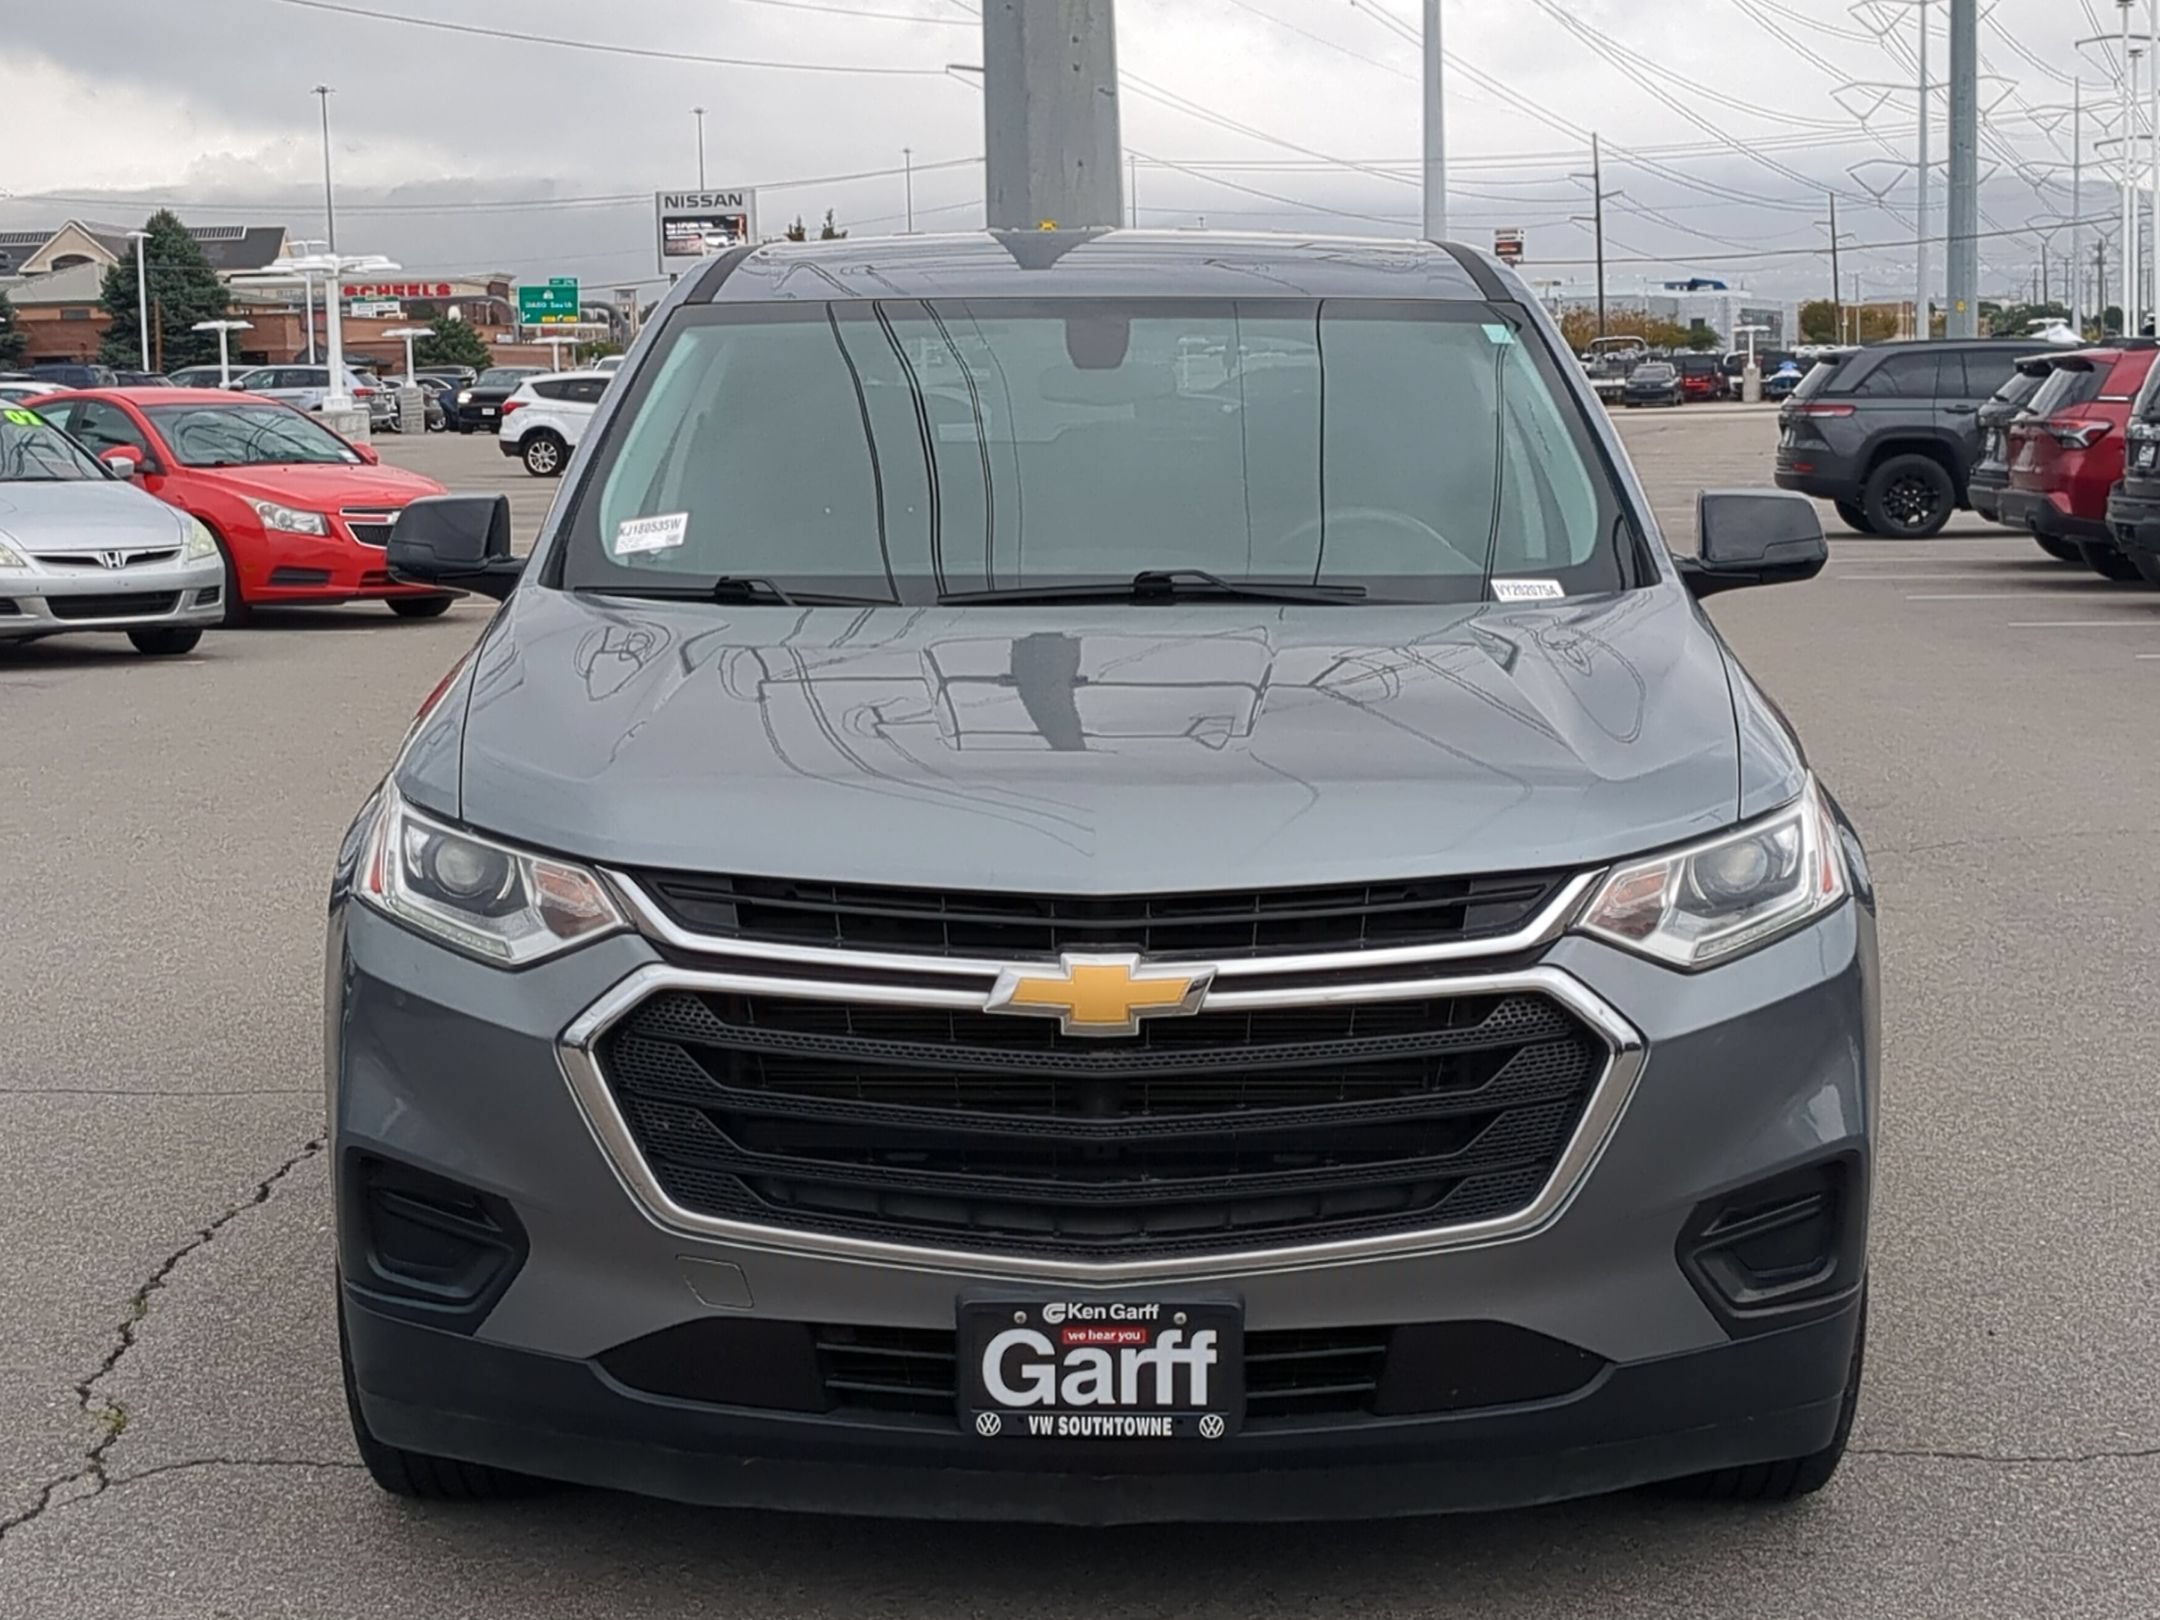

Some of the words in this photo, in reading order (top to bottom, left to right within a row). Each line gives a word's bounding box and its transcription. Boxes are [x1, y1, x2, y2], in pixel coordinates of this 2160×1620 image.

[664, 193, 743, 209] NISSAN
[343, 283, 451, 297] SCHEELS
[3, 409, 44, 426] 07
[1067, 1303, 1107, 1320] Ken
[1109, 1303, 1160, 1320] Garff
[1067, 1330, 1086, 1341] we
[1088, 1329, 1115, 1341] hear
[1117, 1330, 1141, 1344] you
[982, 1328, 1218, 1407] Garff
[1028, 1416, 1053, 1435] VW
[1058, 1416, 1173, 1437] SOUTHTOWNE
